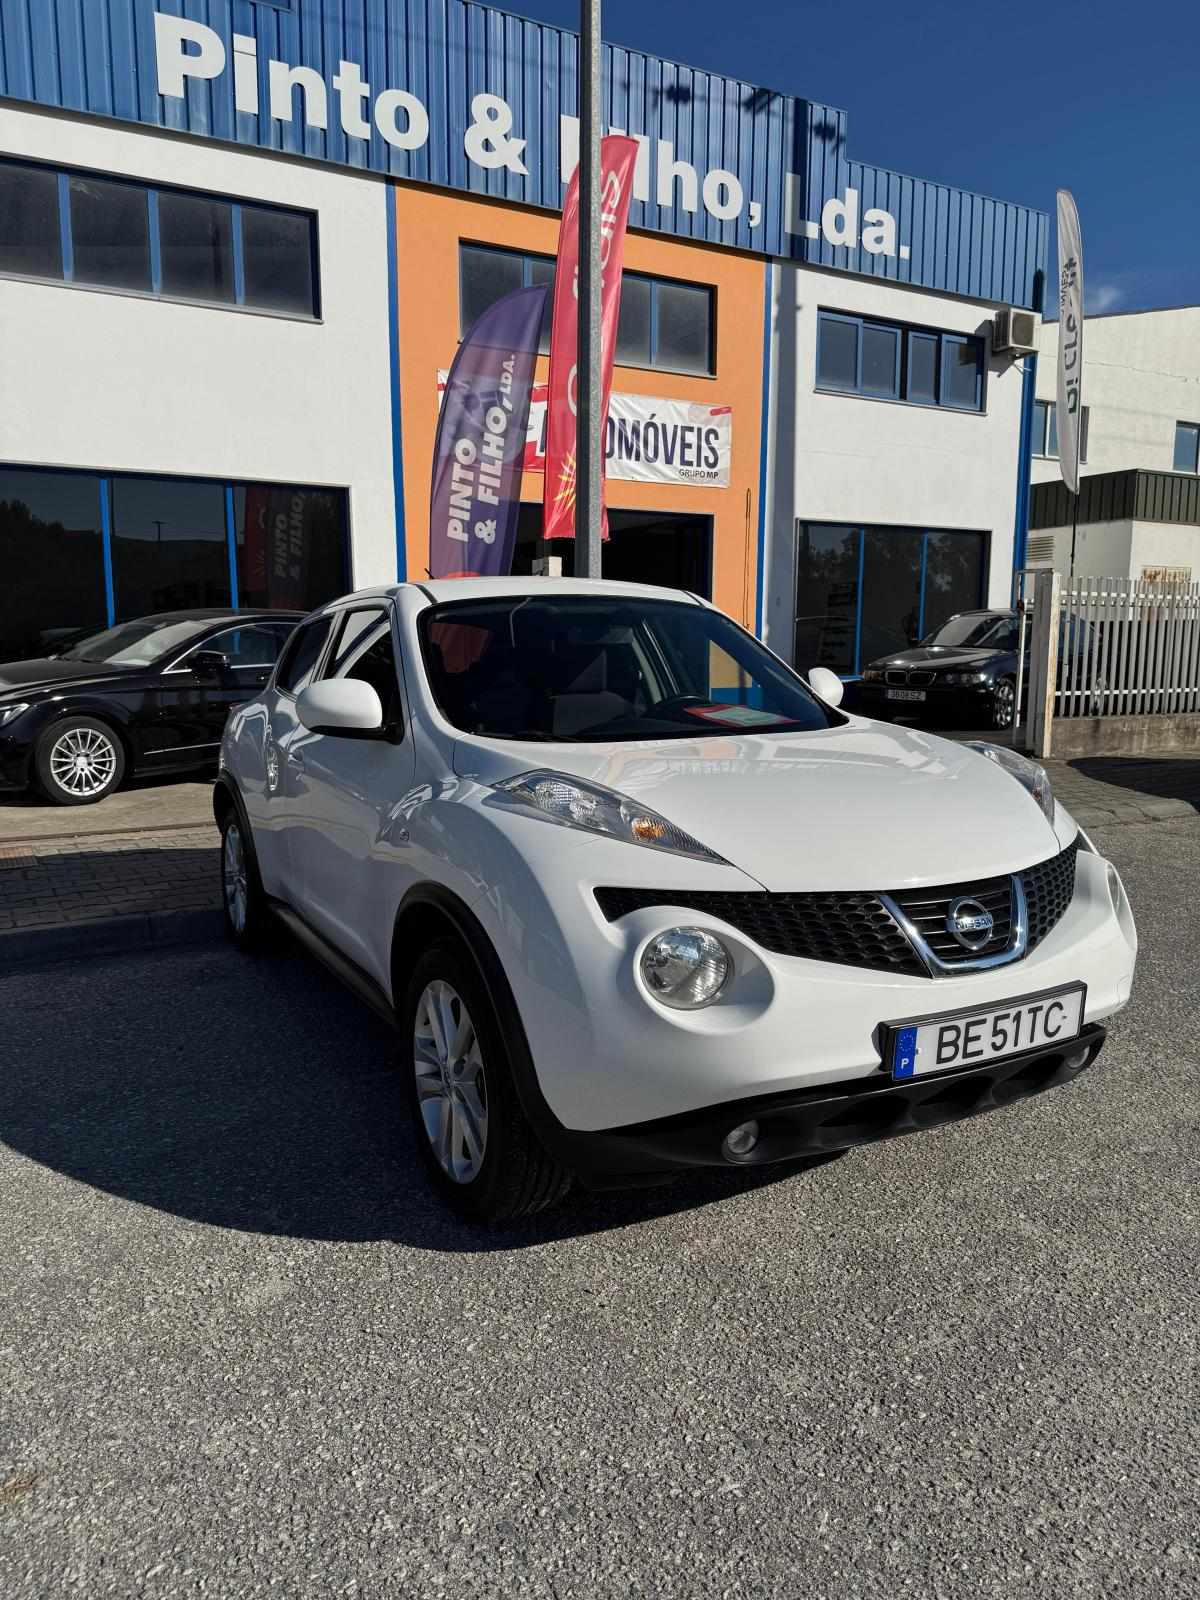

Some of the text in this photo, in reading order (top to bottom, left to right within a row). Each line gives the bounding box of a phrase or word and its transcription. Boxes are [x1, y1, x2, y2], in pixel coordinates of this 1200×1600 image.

[154, 12, 911, 260] Pinto & lho, Lda.
[706, 470, 719, 479] MP
[447, 437, 477, 542] PINTO
[474, 518, 497, 545] &
[900, 1058, 910, 1069] P
